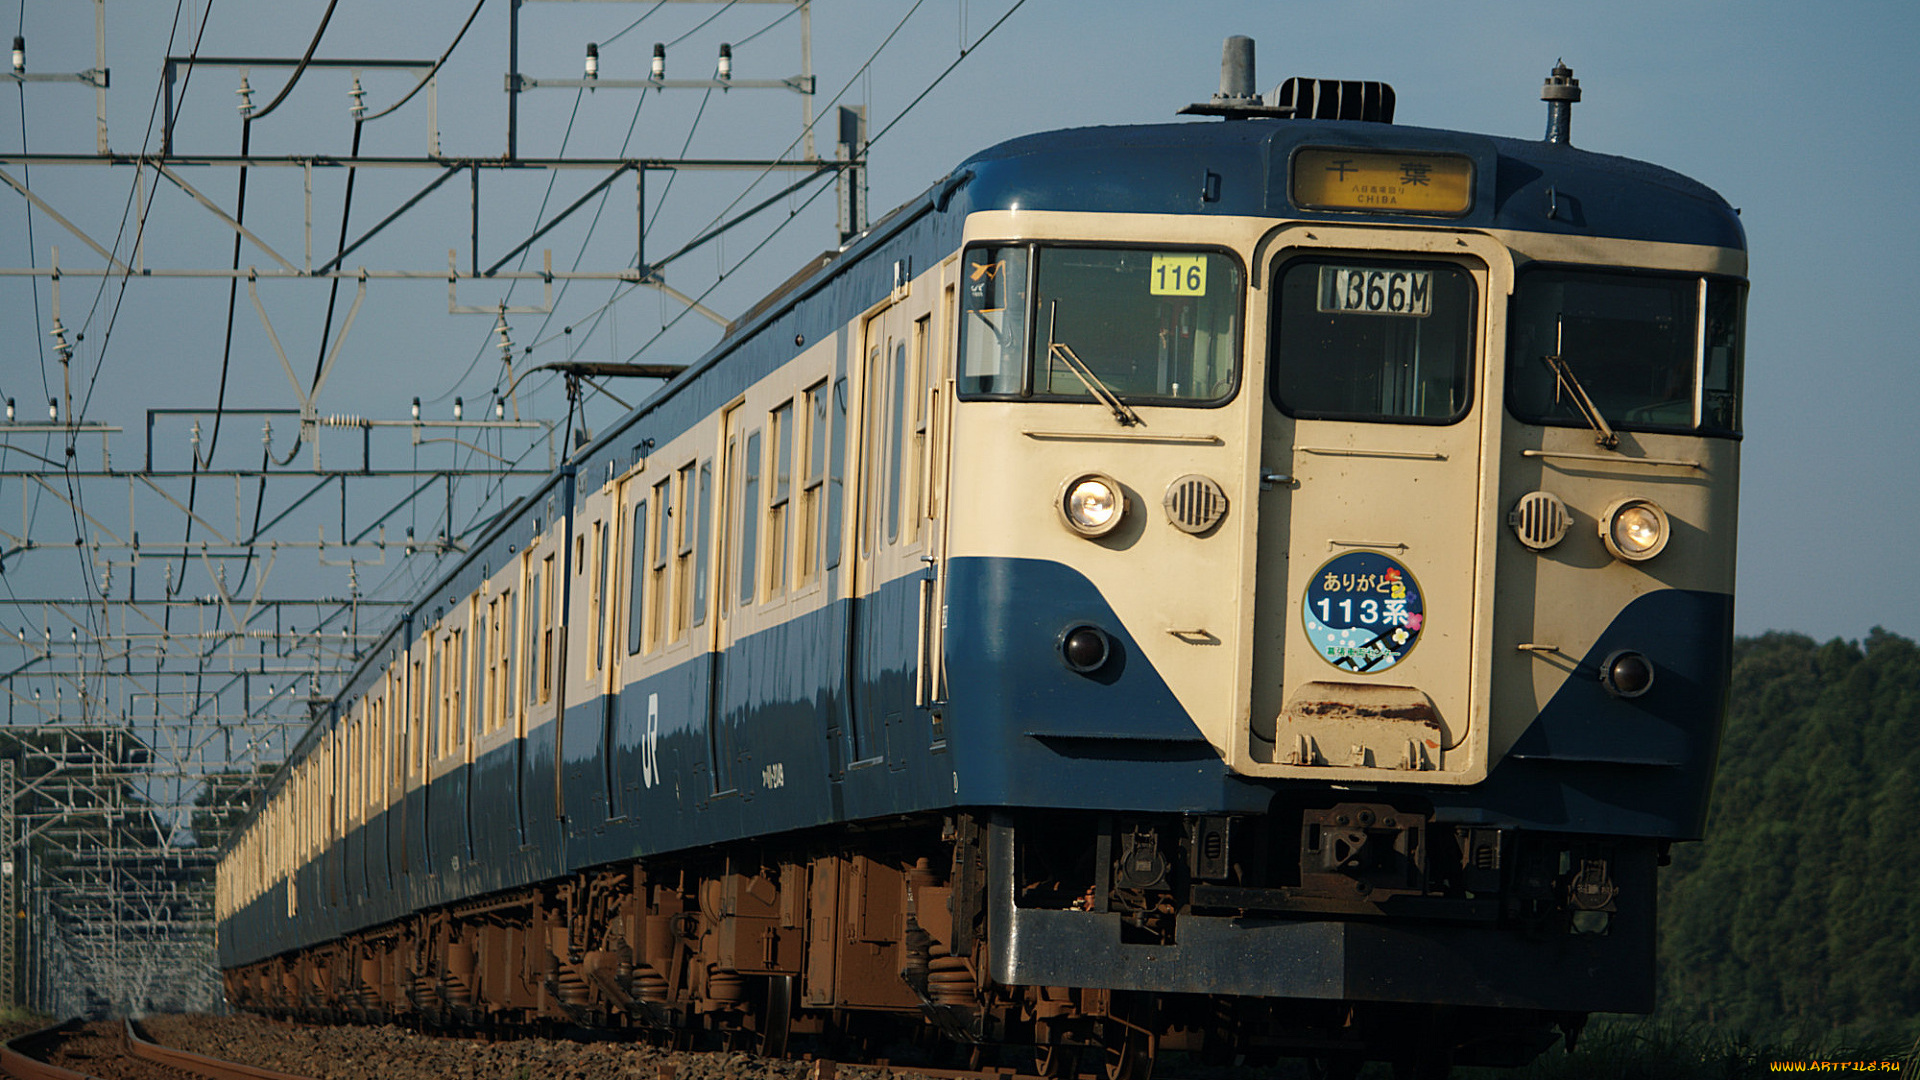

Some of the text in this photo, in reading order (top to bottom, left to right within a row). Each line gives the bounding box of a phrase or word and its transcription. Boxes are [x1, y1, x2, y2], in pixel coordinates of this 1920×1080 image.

[1357, 194, 1397, 204] CHIBA
[1156, 264, 1201, 290] 116
[1323, 571, 1404, 594] ありがとう
[1317, 597, 1409, 626] 113系
[641, 692, 660, 789] JR
